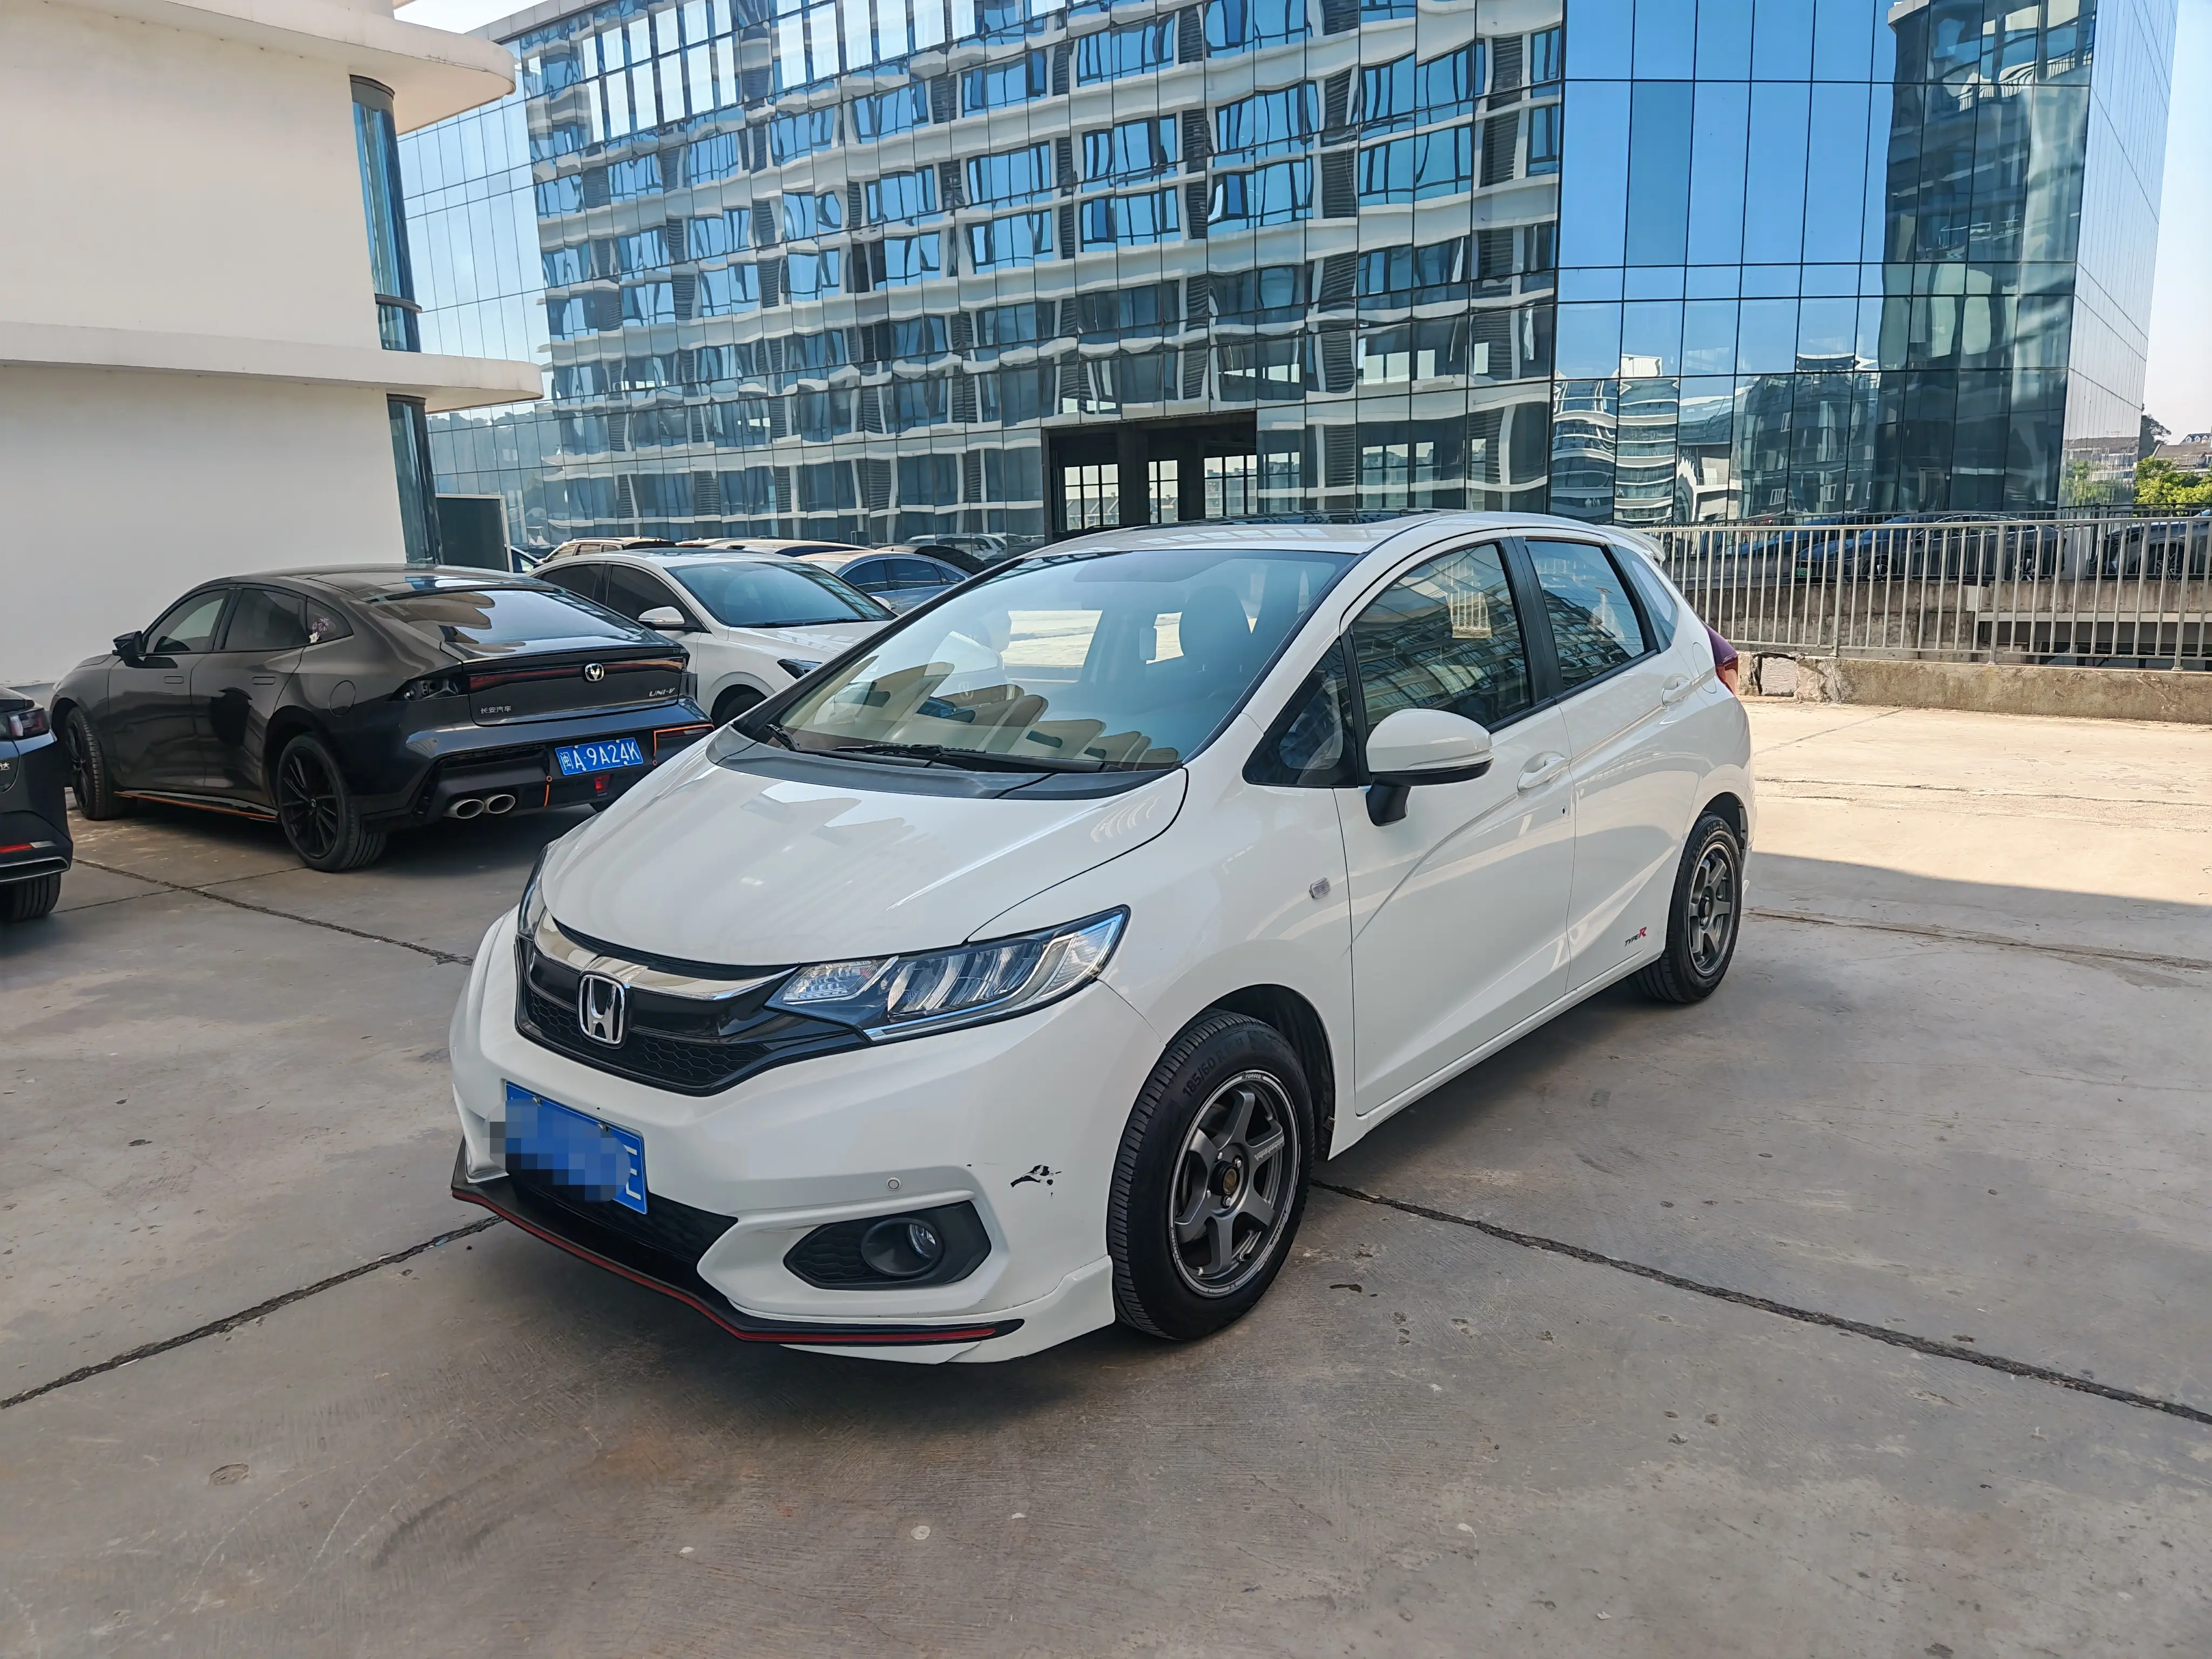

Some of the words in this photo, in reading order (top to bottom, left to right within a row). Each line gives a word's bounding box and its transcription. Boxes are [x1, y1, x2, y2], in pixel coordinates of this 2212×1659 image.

[649, 687, 676, 697] UNI-V
[480, 705, 511, 714] 长安汽车
